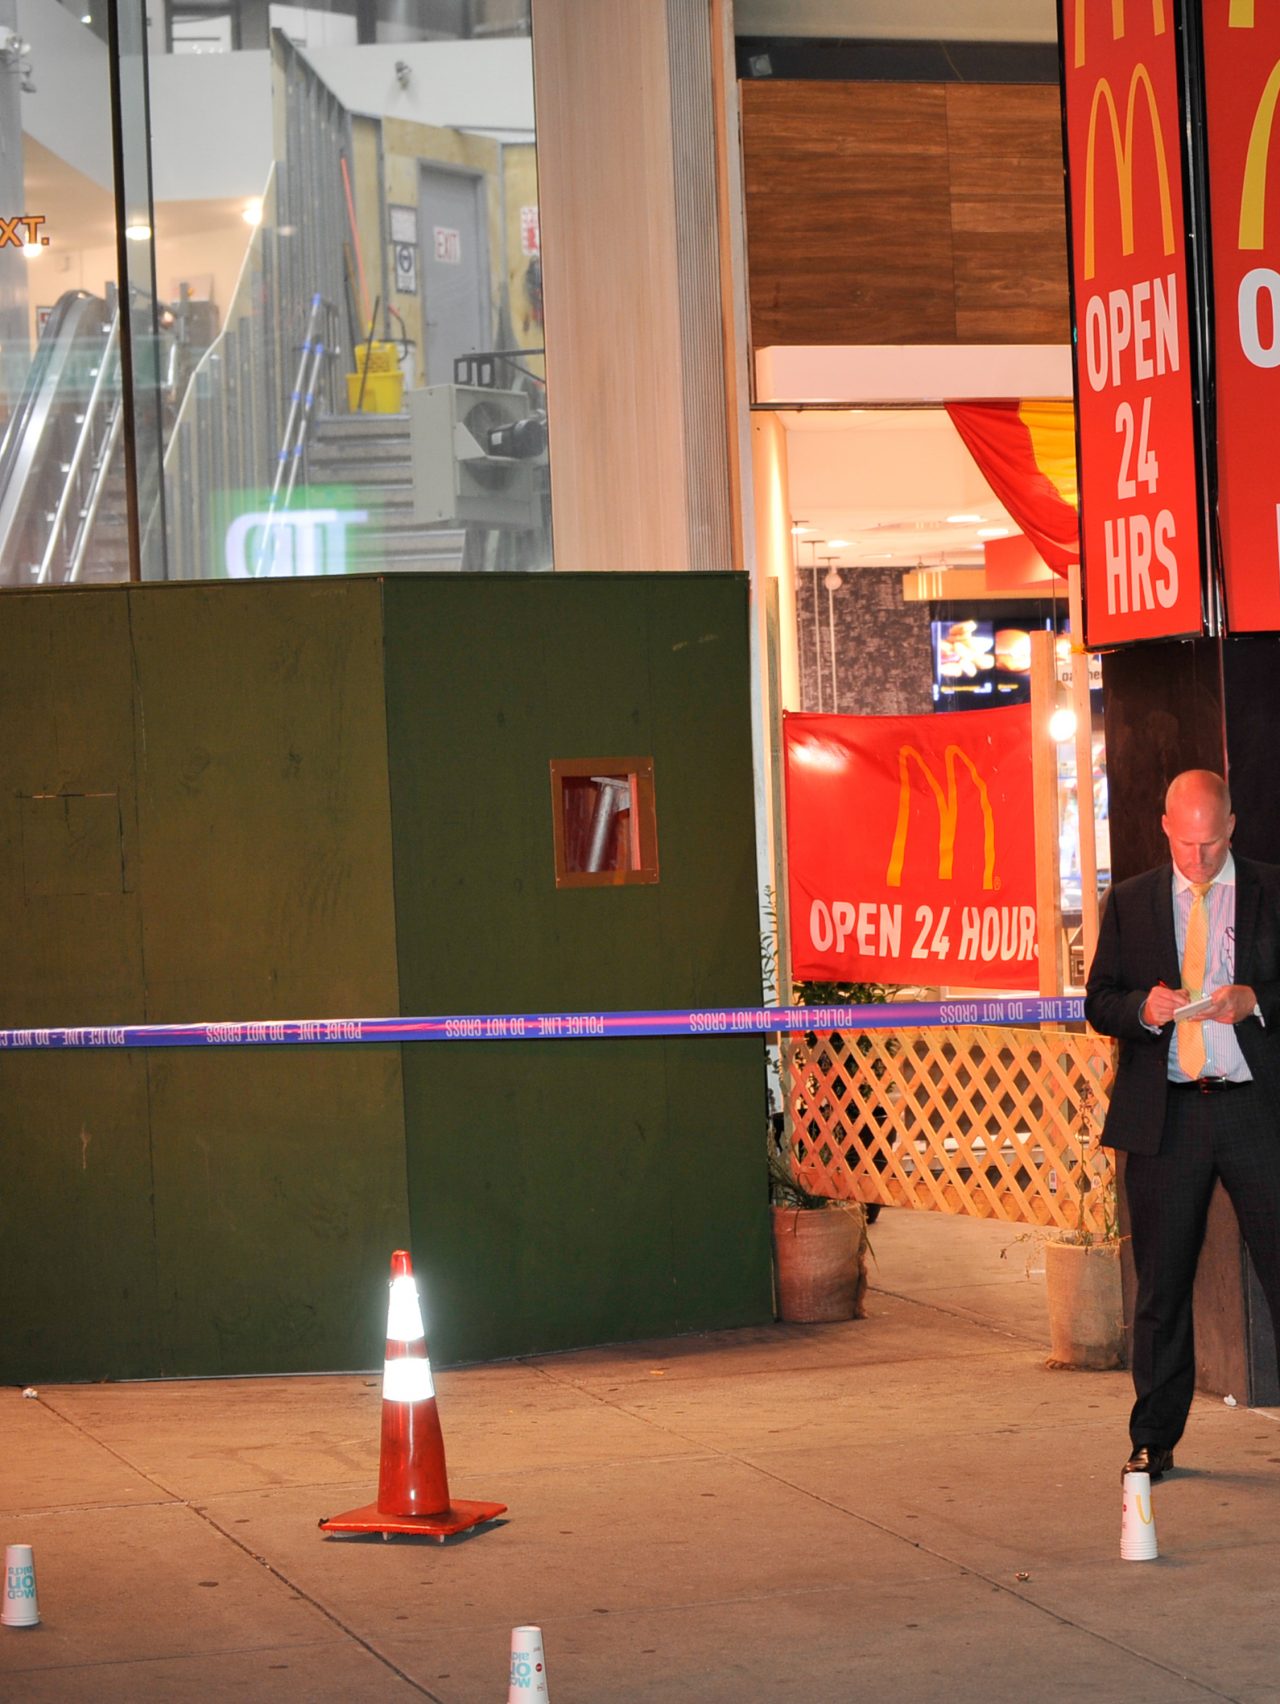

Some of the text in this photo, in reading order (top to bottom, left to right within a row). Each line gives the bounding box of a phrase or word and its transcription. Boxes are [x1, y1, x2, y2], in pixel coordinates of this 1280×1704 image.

[1085, 272, 1180, 393] OPEN
[1115, 396, 1159, 499] 24
[1104, 509, 1178, 615] HRS
[809, 899, 902, 958] OPEN
[911, 905, 950, 960] 24
[689, 1008, 852, 1031] POLICE LINE DO NOT CROSS
[940, 1004, 978, 1024] CROSS
[982, 1003, 1004, 1022] NOT
[1008, 1002, 1023, 1020] DO
[1037, 1001, 1062, 1019] LINE
[206, 1022, 362, 1043] POLICE LINE DO NOT CROSS
[445, 1016, 604, 1037] POLICE LINE DO NOT CROSS
[11, 1031, 32, 1047] NOT
[35, 1031, 49, 1046] DO
[62, 1030, 85, 1046] LINE
[89, 1029, 125, 1045] POLICE
